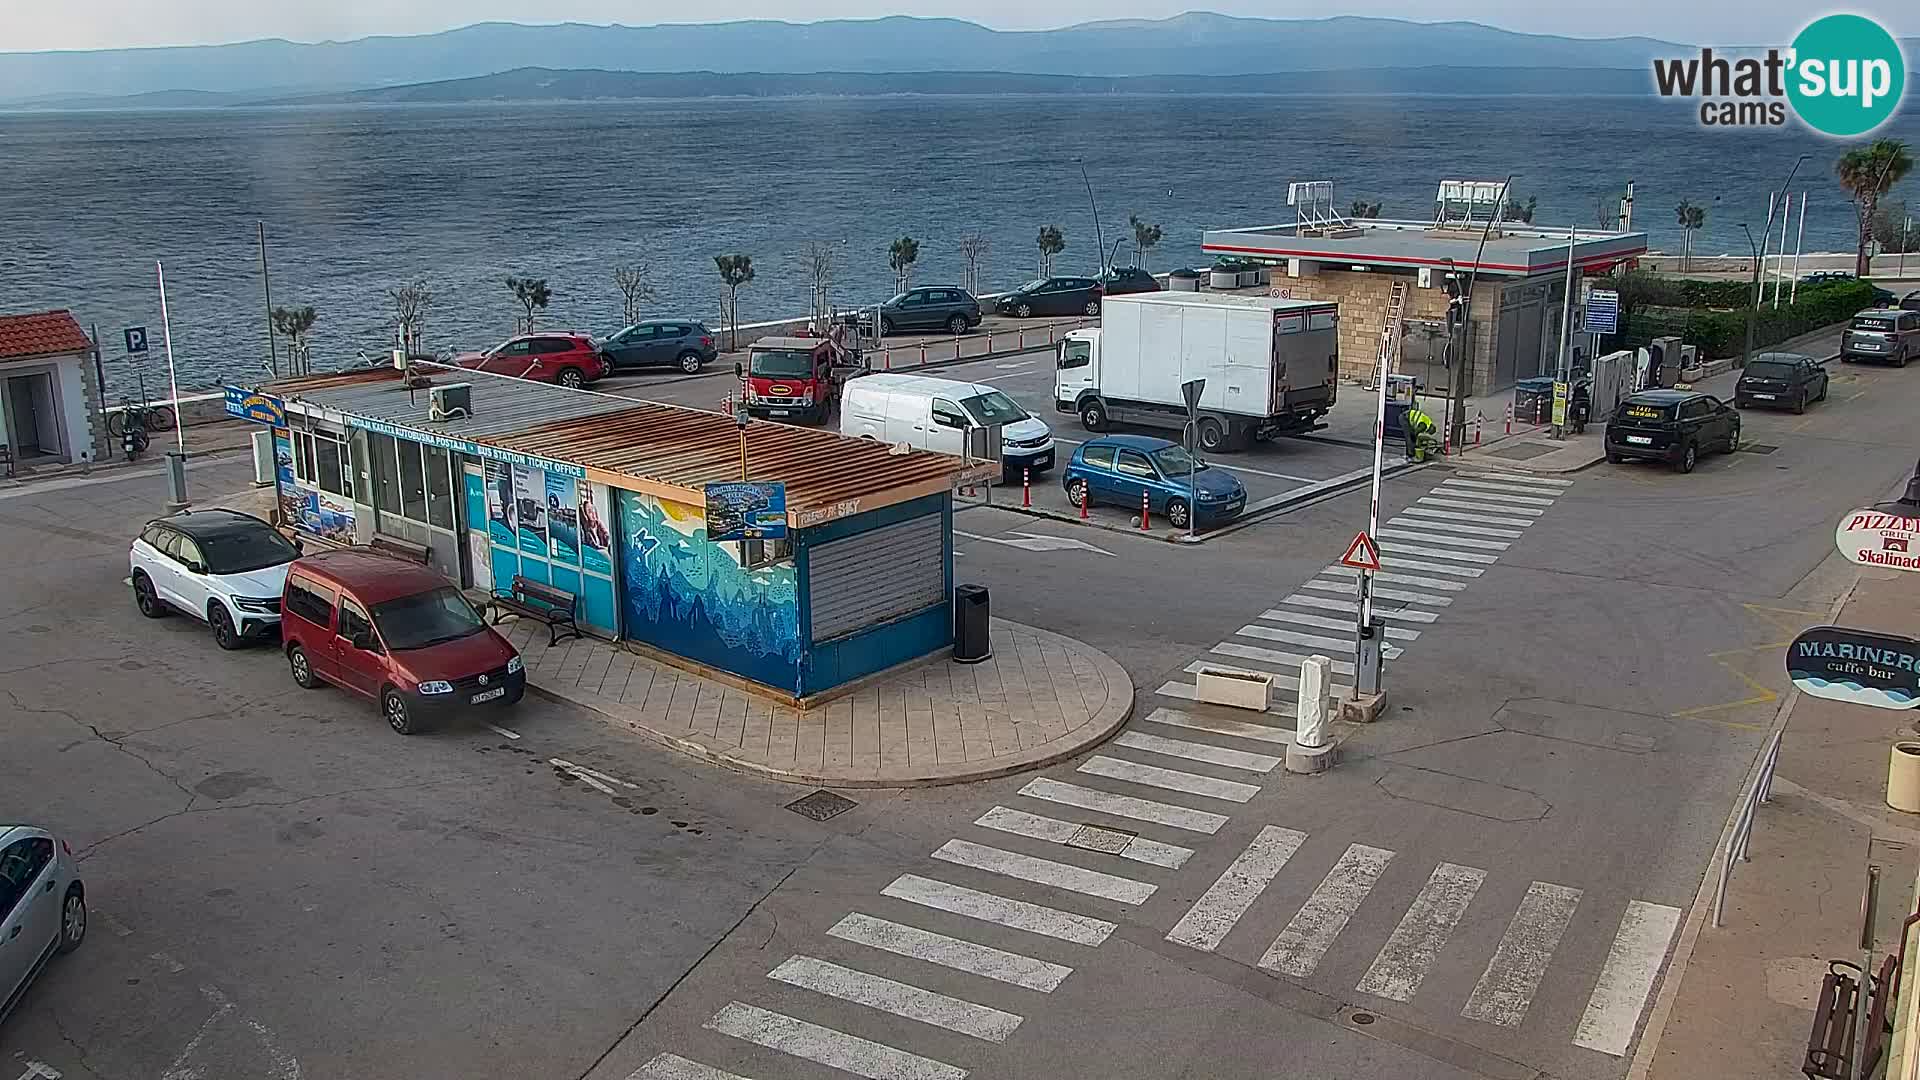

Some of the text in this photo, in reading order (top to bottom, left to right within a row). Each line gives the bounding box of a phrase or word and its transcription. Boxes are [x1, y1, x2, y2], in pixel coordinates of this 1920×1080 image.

[395, 427, 435, 444] AUTOBUSNA
[435, 436, 467, 451] POSTAJA
[478, 446, 492, 457] BUS
[493, 449, 526, 465] STATION
[527, 456, 552, 471] TICKET
[553, 462, 581, 477] OFFICE
[1880, 530, 1915, 540] GRILL
[1827, 662, 1896, 680] caffe bar
